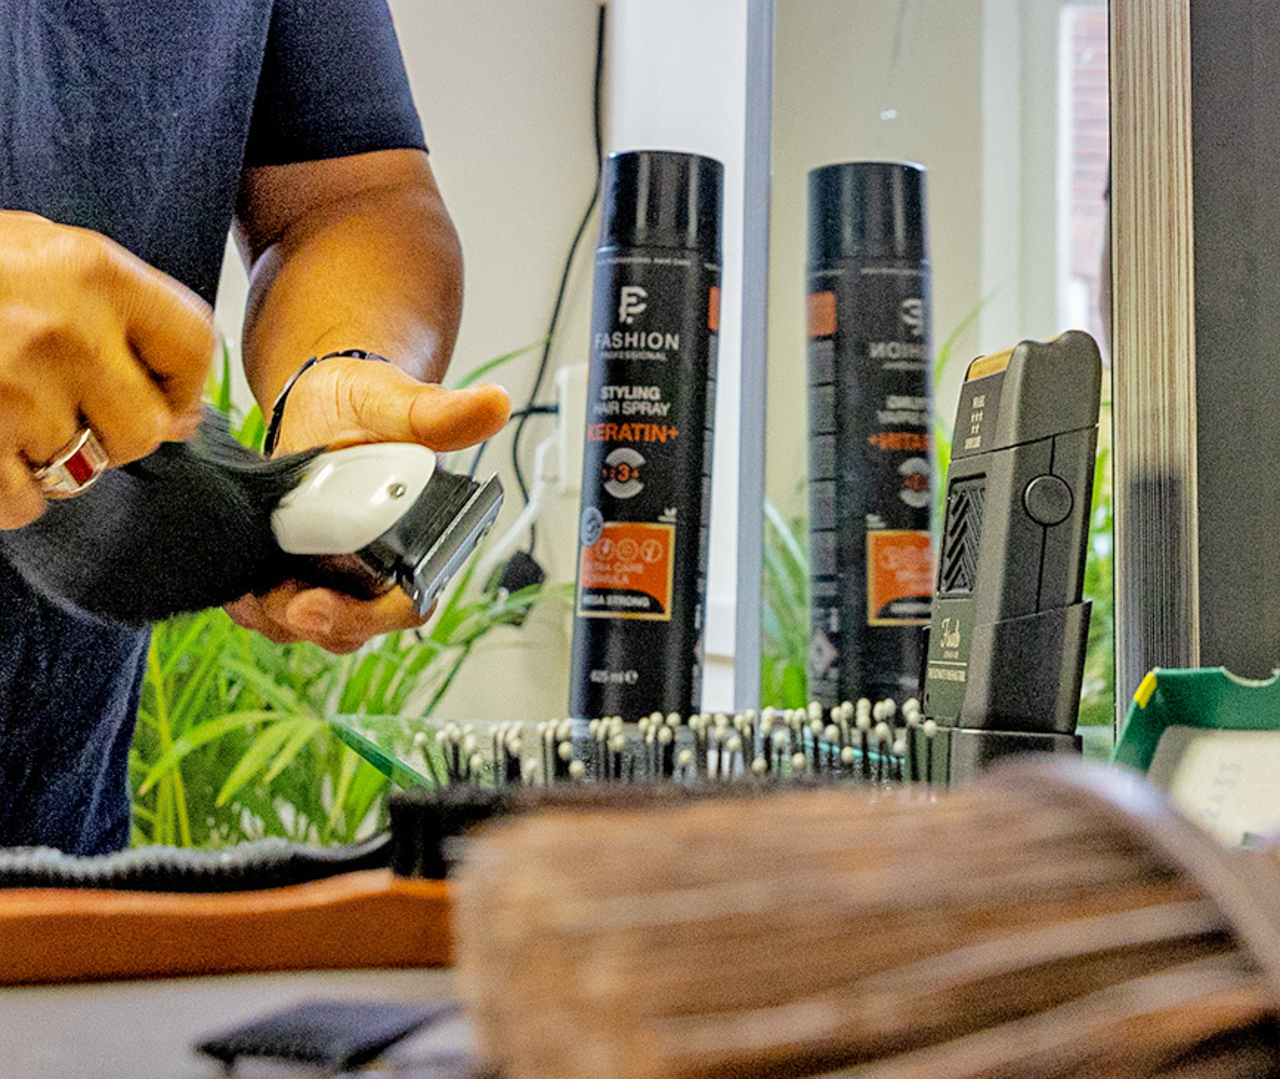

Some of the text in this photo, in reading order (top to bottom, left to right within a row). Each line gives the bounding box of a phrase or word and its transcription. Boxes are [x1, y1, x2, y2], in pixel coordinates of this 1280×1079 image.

[593, 331, 680, 351] FASHION
[600, 385, 661, 400] STYLING
[622, 401, 671, 417] SPRAY
[586, 422, 679, 443] KERATIN+
[618, 463, 631, 482] 3
